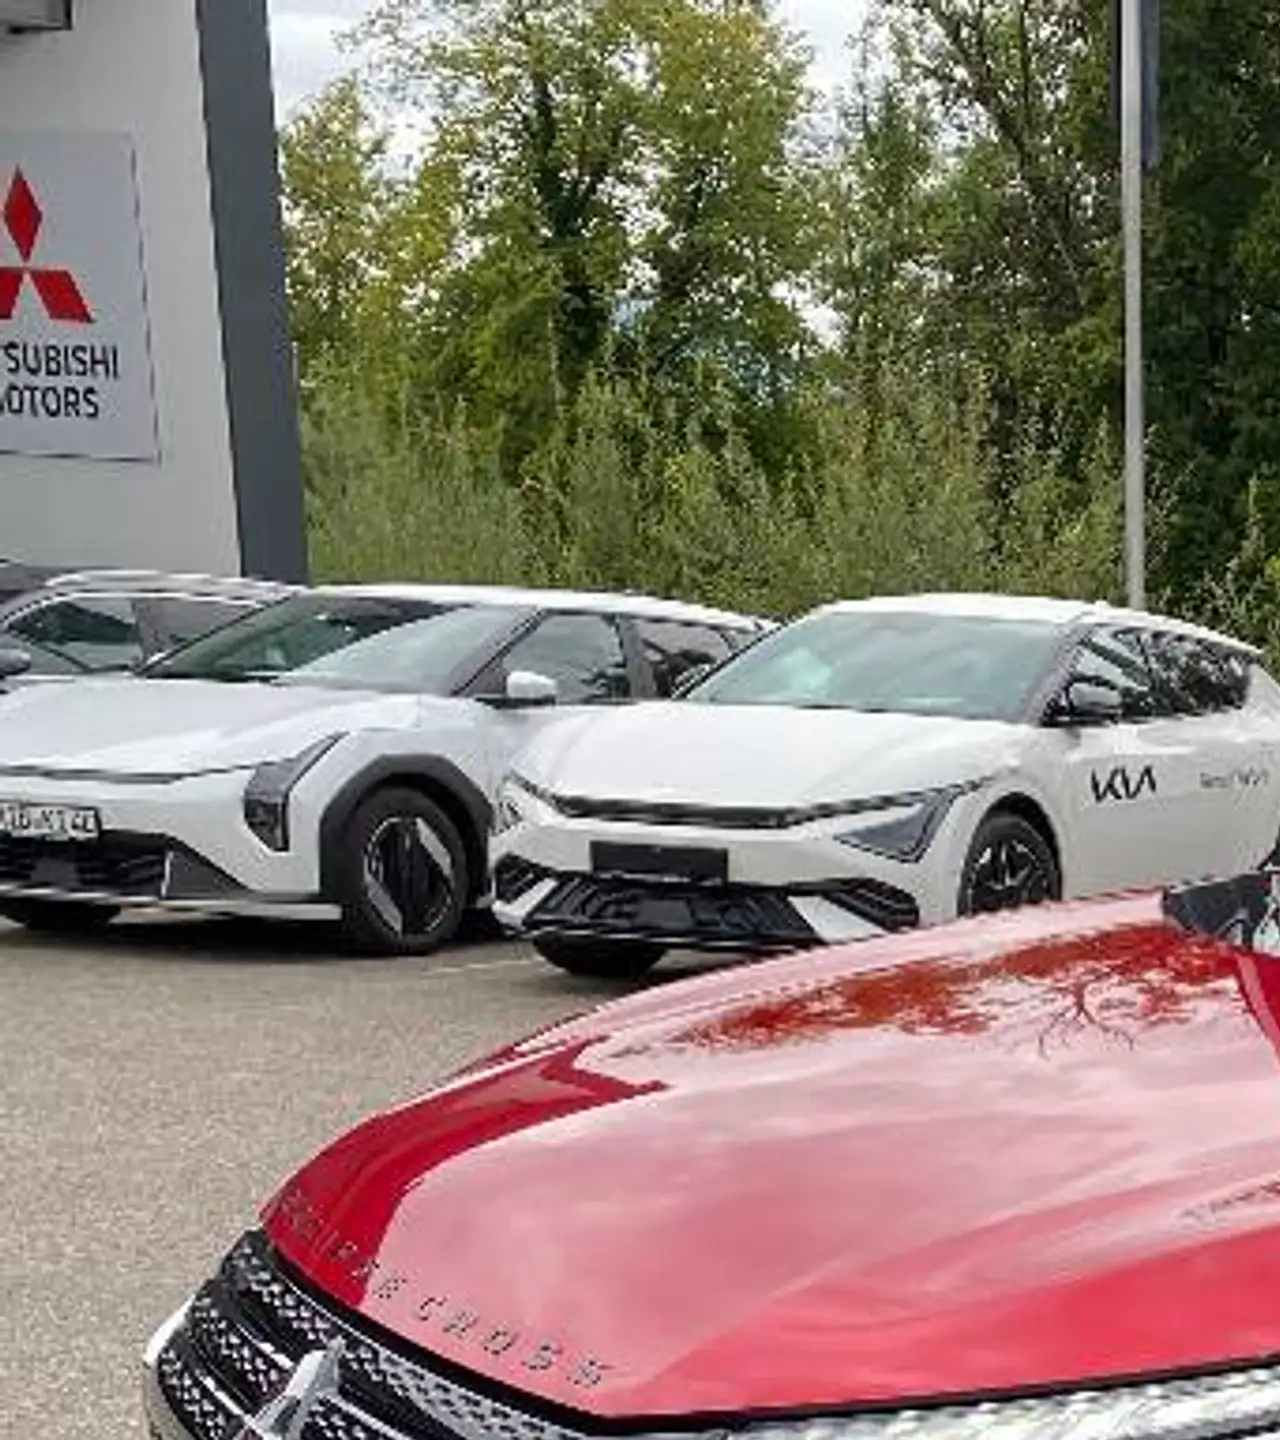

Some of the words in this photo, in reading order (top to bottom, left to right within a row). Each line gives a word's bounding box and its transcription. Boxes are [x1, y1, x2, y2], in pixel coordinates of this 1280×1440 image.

[0, 341, 118, 379] SUBISHI
[0, 384, 99, 418] OTORS
[1091, 765, 1156, 803] KIA
[414, 1296, 607, 1388] CROSS
